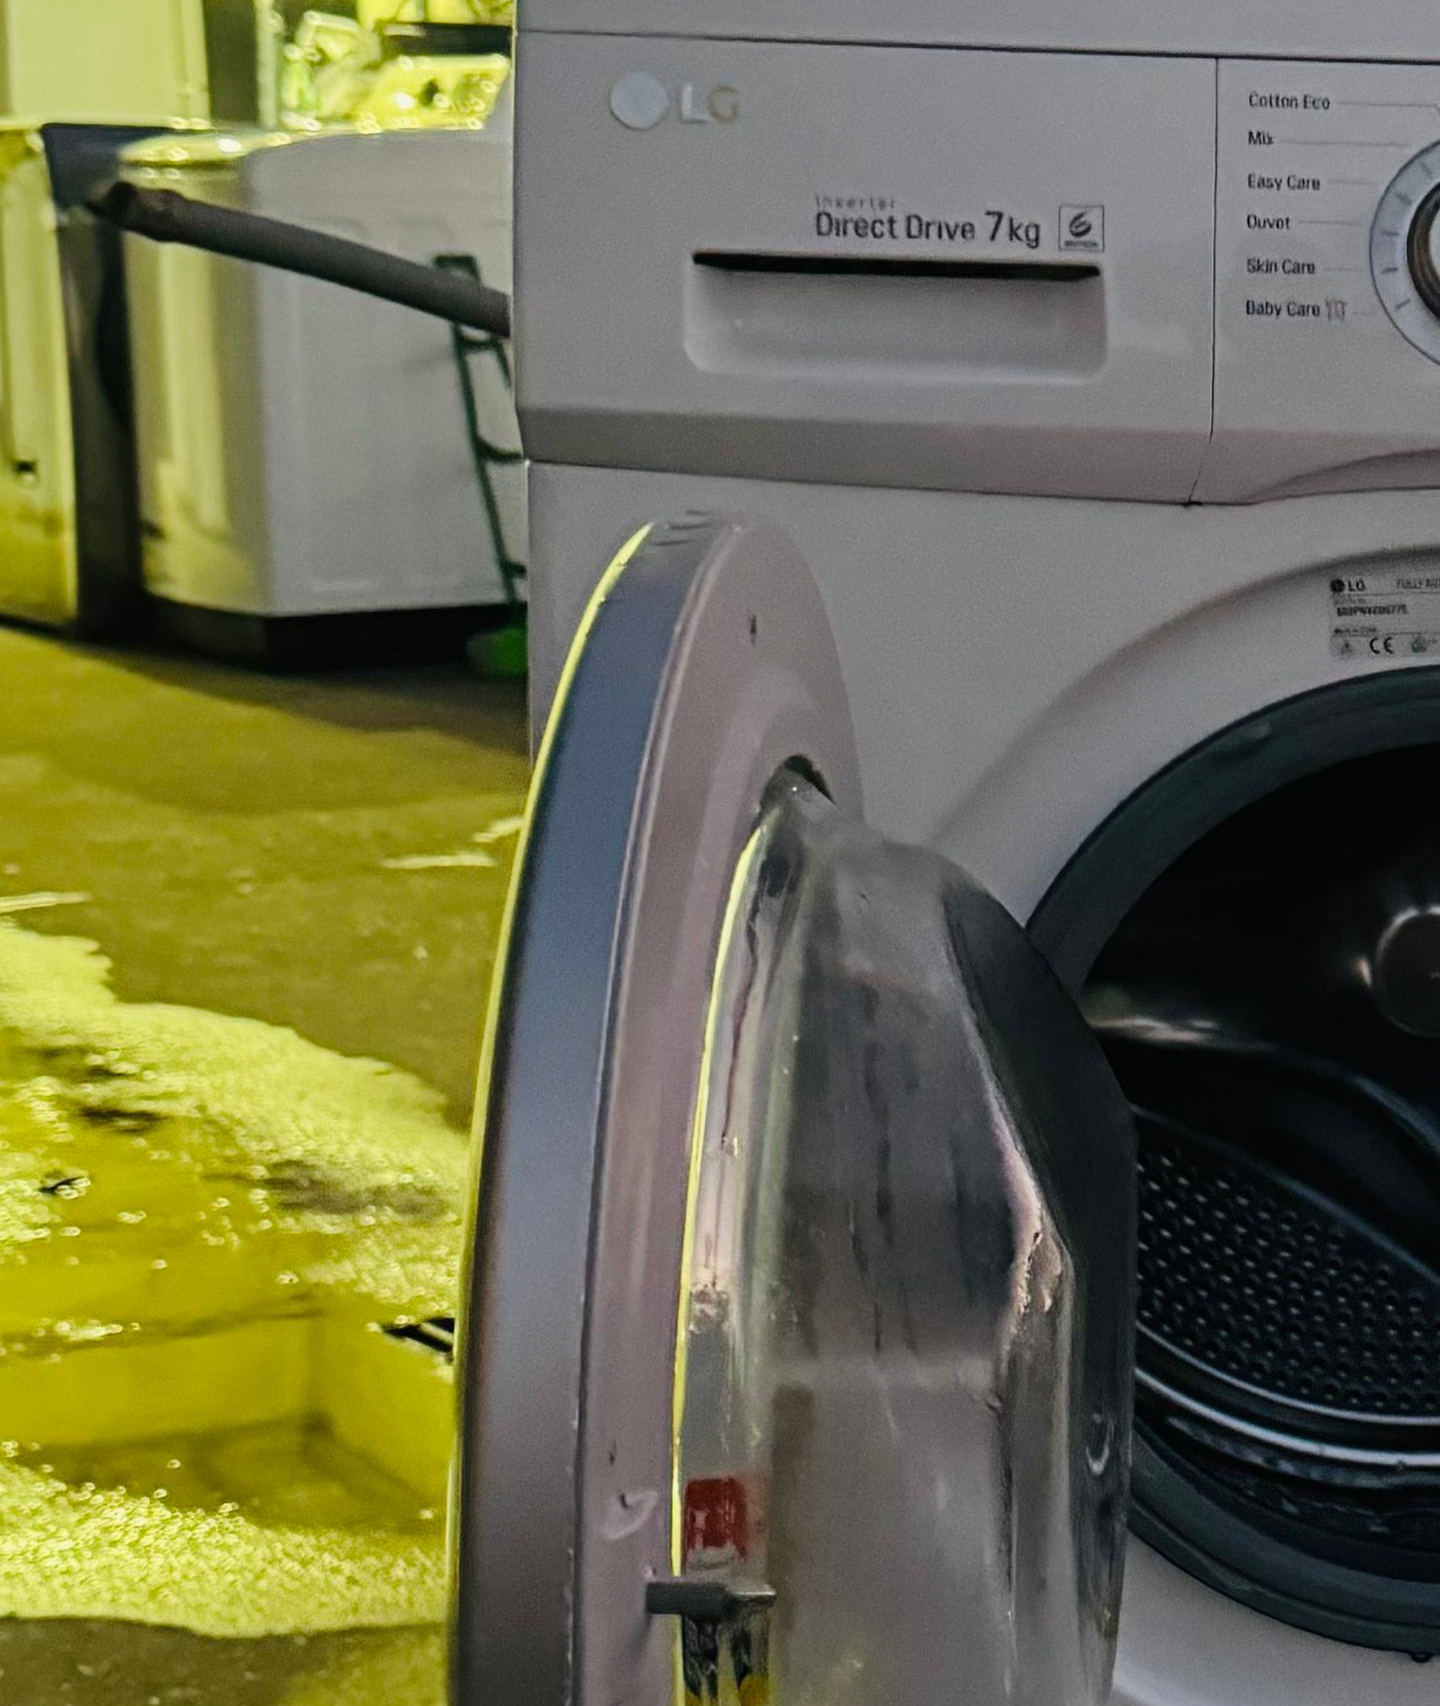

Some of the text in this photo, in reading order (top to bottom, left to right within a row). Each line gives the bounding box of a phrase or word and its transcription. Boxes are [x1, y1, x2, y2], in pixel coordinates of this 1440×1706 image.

[681, 82, 741, 124] LG
[1249, 93, 1331, 110] Cotton Eco
[1247, 131, 1275, 146] Mix
[1247, 174, 1321, 192] Easy Care
[815, 211, 899, 240] Direct
[905, 214, 976, 241] Drive
[1246, 215, 1291, 230] Duvet
[1246, 258, 1316, 275] Skin Care
[1246, 300, 1321, 319] Baby Care
